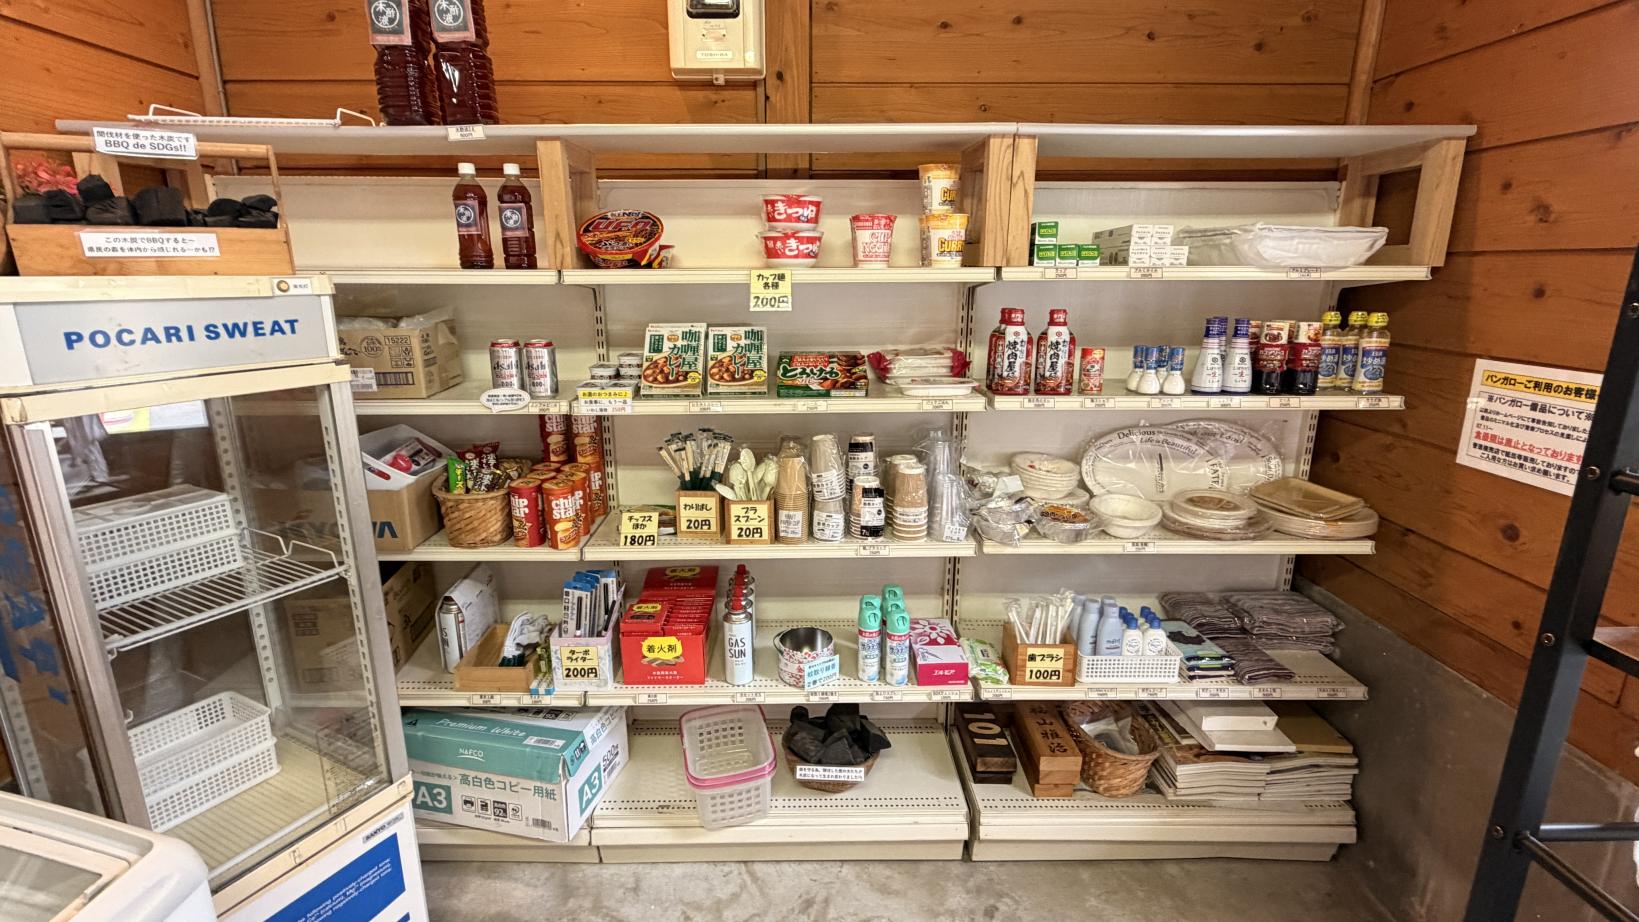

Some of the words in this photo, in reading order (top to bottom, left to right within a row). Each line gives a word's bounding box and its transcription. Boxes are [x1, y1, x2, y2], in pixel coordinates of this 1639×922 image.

[104, 140, 130, 150] BBQ
[132, 142, 146, 150] de
[150, 142, 186, 152] SDGs!!
[756, 272, 786, 282] カップ麺
[763, 282, 780, 290] 各種
[63, 324, 196, 350] POCARI
[204, 318, 300, 340] SWEAT
[780, 364, 840, 379] とろける
[1486, 374, 1597, 400] バンガローご利用のお客様
[1117, 429, 1156, 440] Delicious
[1161, 438, 1198, 455] Beautiful
[682, 503, 712, 511] わりばし
[686, 519, 712, 530] 20円
[738, 528, 763, 538] 20円
[623, 535, 655, 546] 180円
[646, 644, 677, 653] 着火剤
[728, 638, 746, 648] GAS
[728, 649, 746, 659] SUN
[1028, 653, 1063, 663] 歯ブラシ
[565, 668, 598, 678] 200円
[1028, 669, 1060, 680] 100円
[435, 718, 488, 732] Premium
[490, 724, 526, 737] White
[459, 748, 484, 758] NAFCO
[459, 773, 557, 801] 高白色コピー用紙
[582, 774, 600, 808] A3
[416, 786, 447, 808] A3
[365, 824, 386, 841] SANYO
